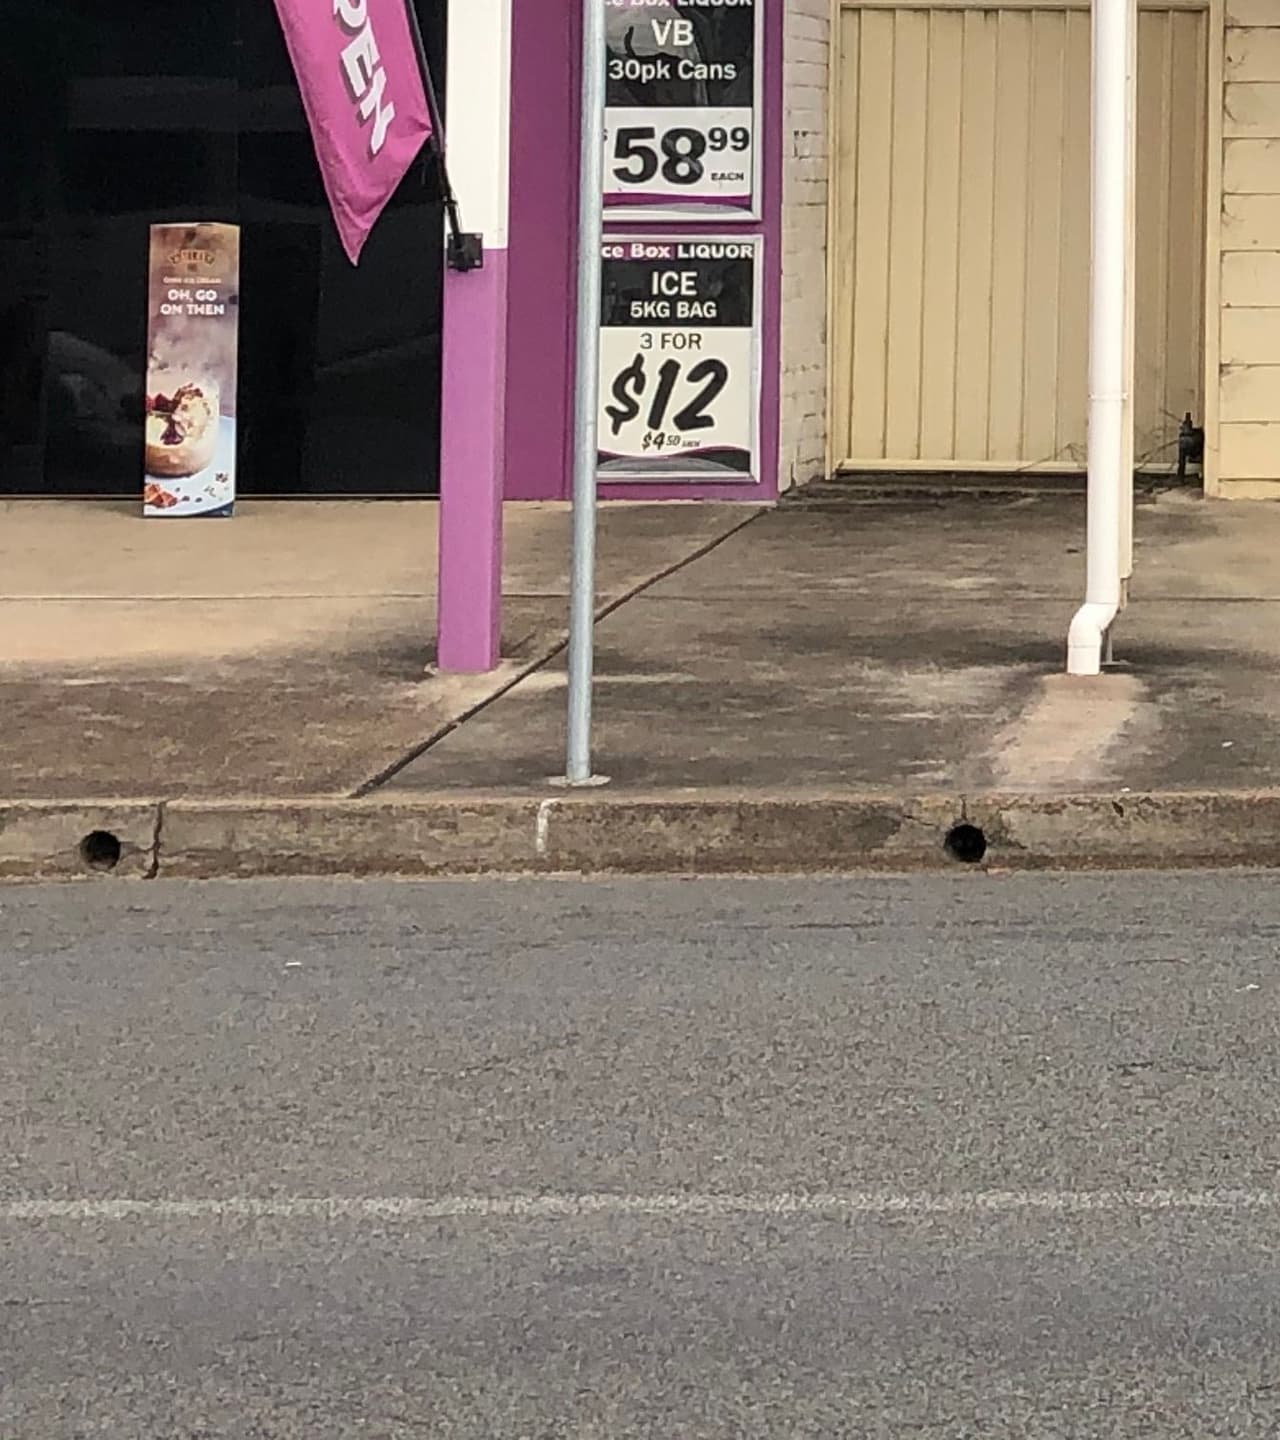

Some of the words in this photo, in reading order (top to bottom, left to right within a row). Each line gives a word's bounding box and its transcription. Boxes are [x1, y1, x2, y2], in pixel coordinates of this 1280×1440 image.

[651, 19, 694, 46] VB
[608, 60, 671, 83] 30pk
[678, 60, 737, 79] Cans
[601, 246, 624, 258] ce
[630, 243, 671, 258] Box
[677, 245, 753, 258] LIQUOR
[652, 271, 698, 296] ICE
[195, 289, 217, 301] GO
[160, 304, 182, 315] ON
[186, 304, 224, 315] THEN
[630, 301, 670, 318] 5KG
[676, 301, 717, 318] BAG
[639, 333, 653, 349] 3
[661, 333, 702, 349] FOR
[605, 353, 728, 436] $12
